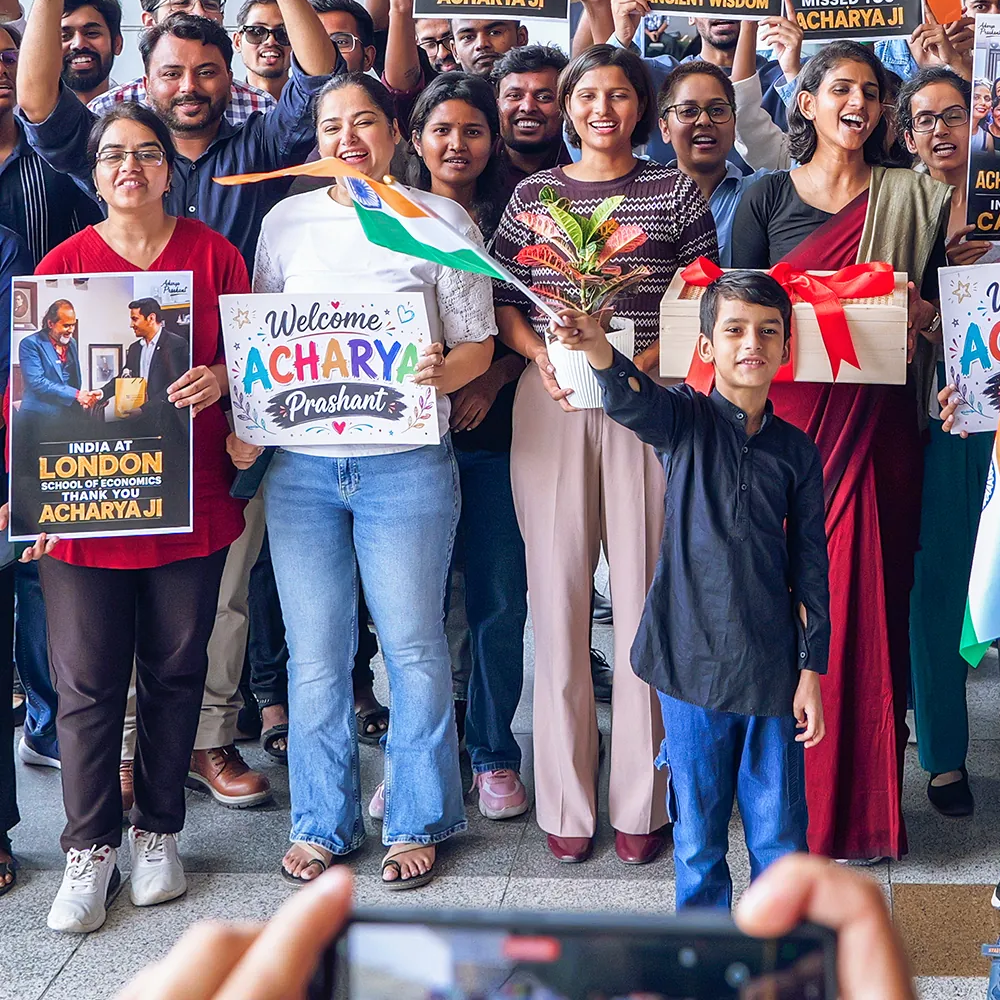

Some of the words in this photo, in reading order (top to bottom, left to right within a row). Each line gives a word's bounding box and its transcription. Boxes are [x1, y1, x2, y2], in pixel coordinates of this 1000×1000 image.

[796, 8, 886, 30] ACHARYA
[887, 7, 904, 26] JI
[264, 302, 383, 340] Welcome
[241, 337, 419, 395] ACHARYA
[285, 384, 389, 422] Prashant
[68, 441, 111, 454] INDIA
[114, 440, 133, 451] AT
[39, 451, 163, 480] LONDON
[41, 480, 82, 490] SCHOOL
[85, 480, 99, 489] OF
[100, 476, 162, 487] ECONOMICS
[61, 489, 108, 501] THANK
[111, 488, 140, 499] YOU
[38, 501, 141, 523] ACHARYA
[143, 498, 163, 517] JI
